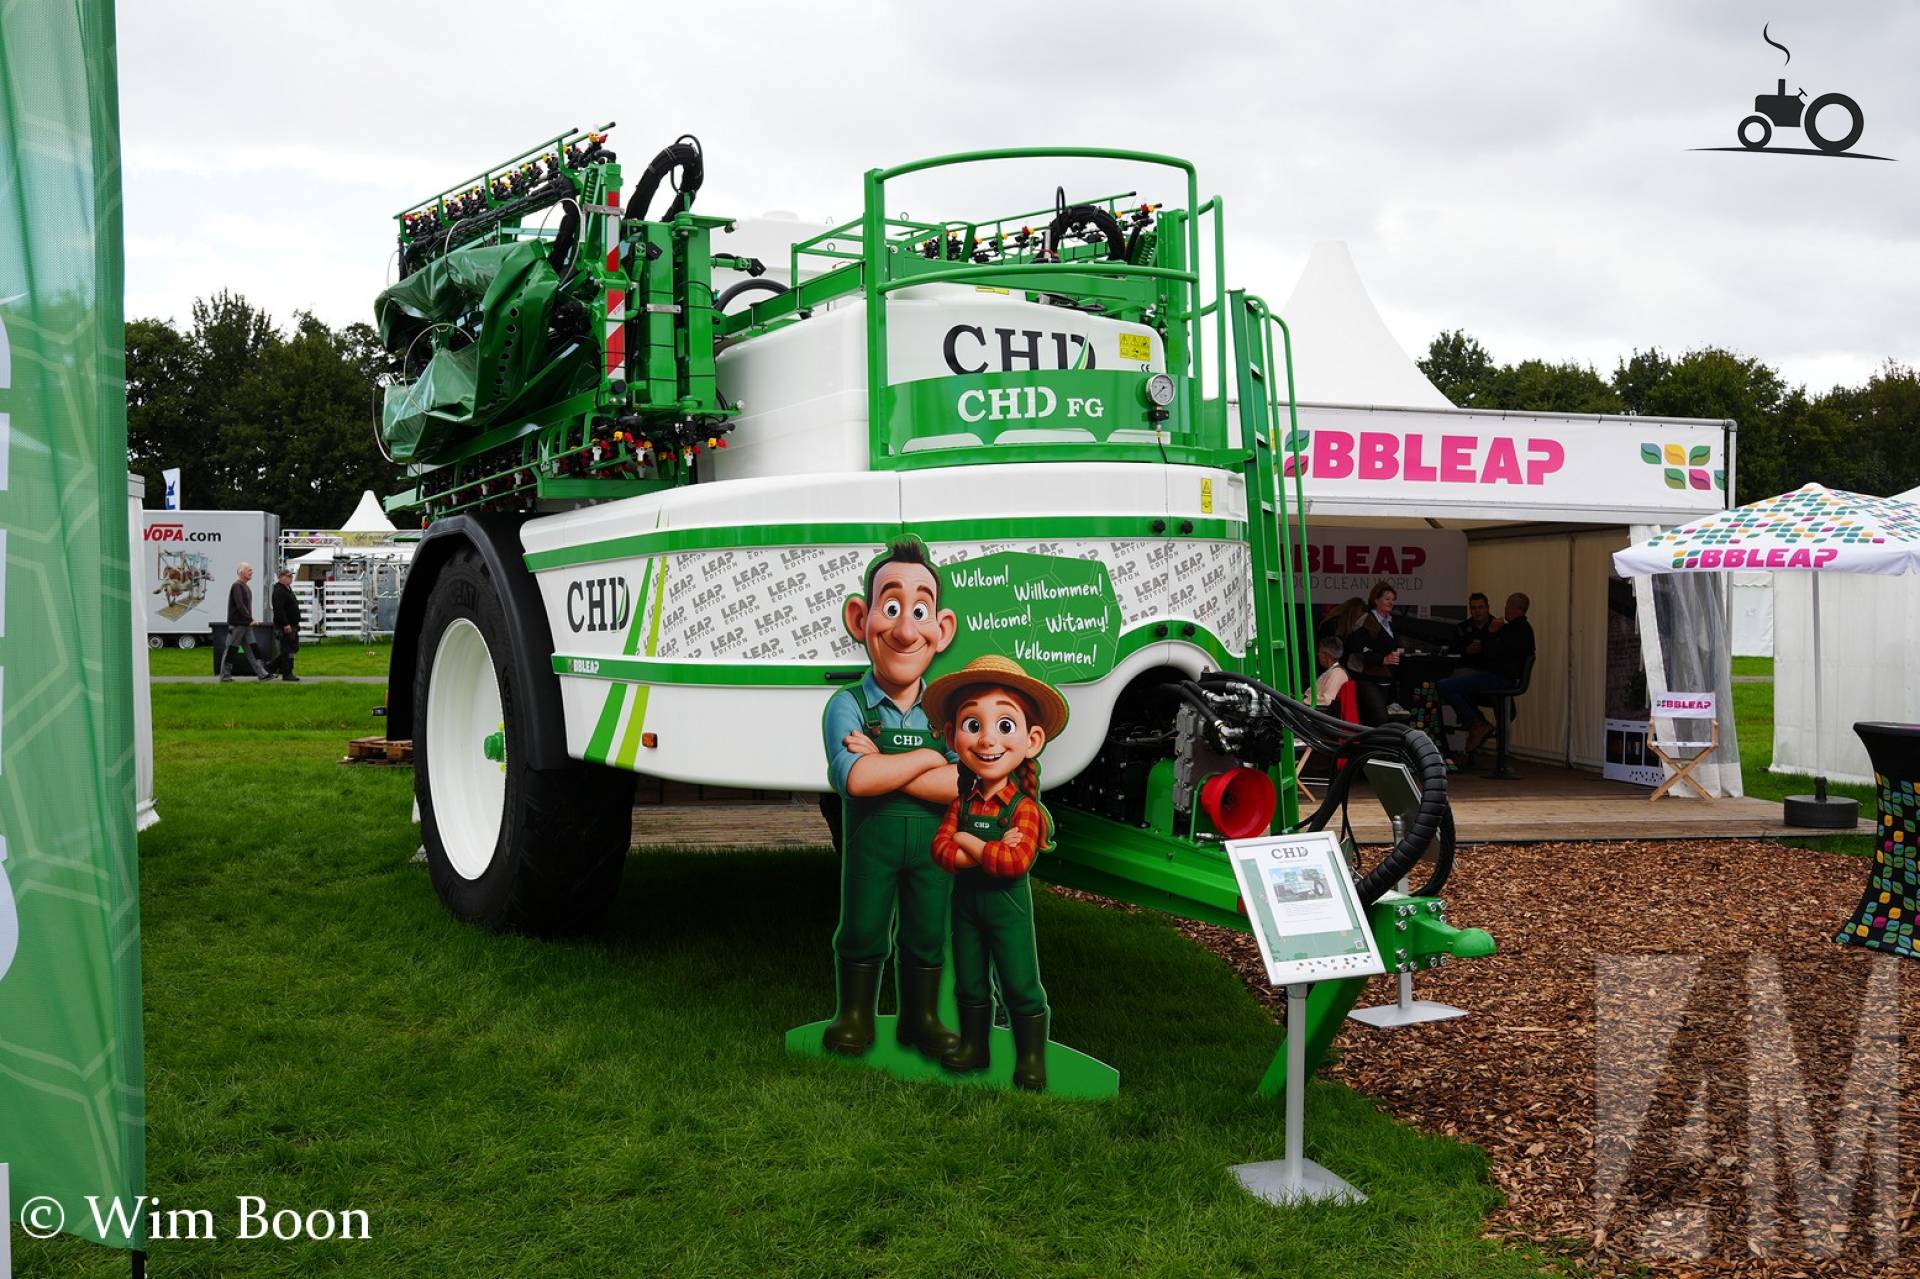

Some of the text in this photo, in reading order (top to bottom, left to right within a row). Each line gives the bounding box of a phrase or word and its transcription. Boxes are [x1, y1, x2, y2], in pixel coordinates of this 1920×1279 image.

[943, 324, 1096, 375] CHD
[957, 386, 1104, 423] CHD FG
[1312, 430, 1565, 485] BBLEAP
[701, 552, 734, 576] LEAP
[818, 551, 859, 576] LEAP
[1110, 560, 1136, 580] EAP
[1174, 552, 1203, 576] LEAP
[1281, 543, 1426, 575] BLEAP
[1699, 548, 1838, 568] BBLEAP
[732, 562, 768, 586] LEAP
[736, 572, 772, 592] EDITION
[823, 560, 864, 581] EDITION
[951, 565, 1009, 588] Welkom!
[1201, 564, 1224, 588] LEAP
[669, 574, 694, 598] LEAP
[767, 573, 806, 598] LEAP
[772, 583, 811, 602] EDITION
[1014, 573, 1103, 602] Willkommen!
[1134, 573, 1168, 597] LEAP
[1138, 586, 1167, 604] EDITIO
[1324, 576, 1369, 590] CLEAN
[567, 576, 630, 633] CHD
[692, 584, 722, 608] LEAP
[721, 595, 756, 619] LEAP
[805, 584, 846, 608] LEAP
[809, 592, 848, 614] EDITIO
[1193, 596, 1218, 620] LEAP
[725, 604, 760, 624] EDITION
[754, 605, 793, 630] LEAP
[759, 615, 797, 636] EDITION
[966, 604, 1032, 632] Welcome!
[1046, 606, 1109, 634] Witamy!
[684, 616, 712, 640] LEAP
[710, 627, 744, 651] LEAP
[792, 616, 832, 640] LEAP
[796, 626, 836, 646] EDITION
[1014, 640, 1096, 667] Velkommen!
[573, 659, 600, 674] BBLEAP
[1666, 700, 1712, 710] BBLEAP
[893, 734, 923, 746] CHD
[1271, 846, 1309, 860] CHD
